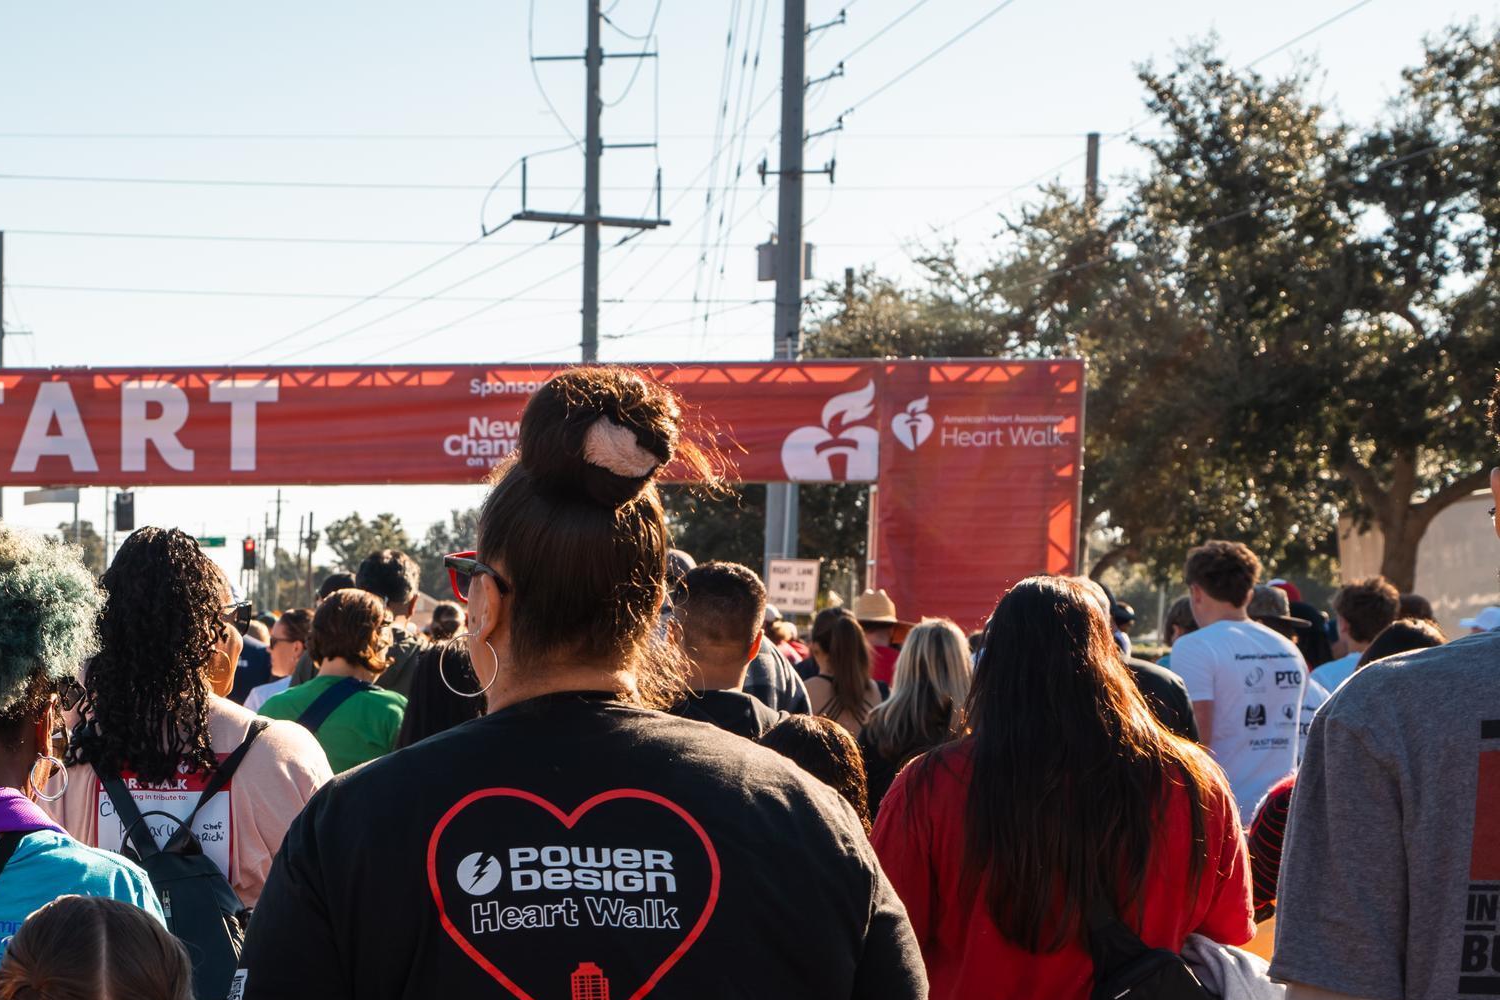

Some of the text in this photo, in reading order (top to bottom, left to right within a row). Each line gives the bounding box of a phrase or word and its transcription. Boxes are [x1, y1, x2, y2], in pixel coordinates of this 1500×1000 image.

[941, 426, 1004, 447] Heart
[779, 581, 806, 592] MUST
[471, 896, 681, 934] Heart Walk
